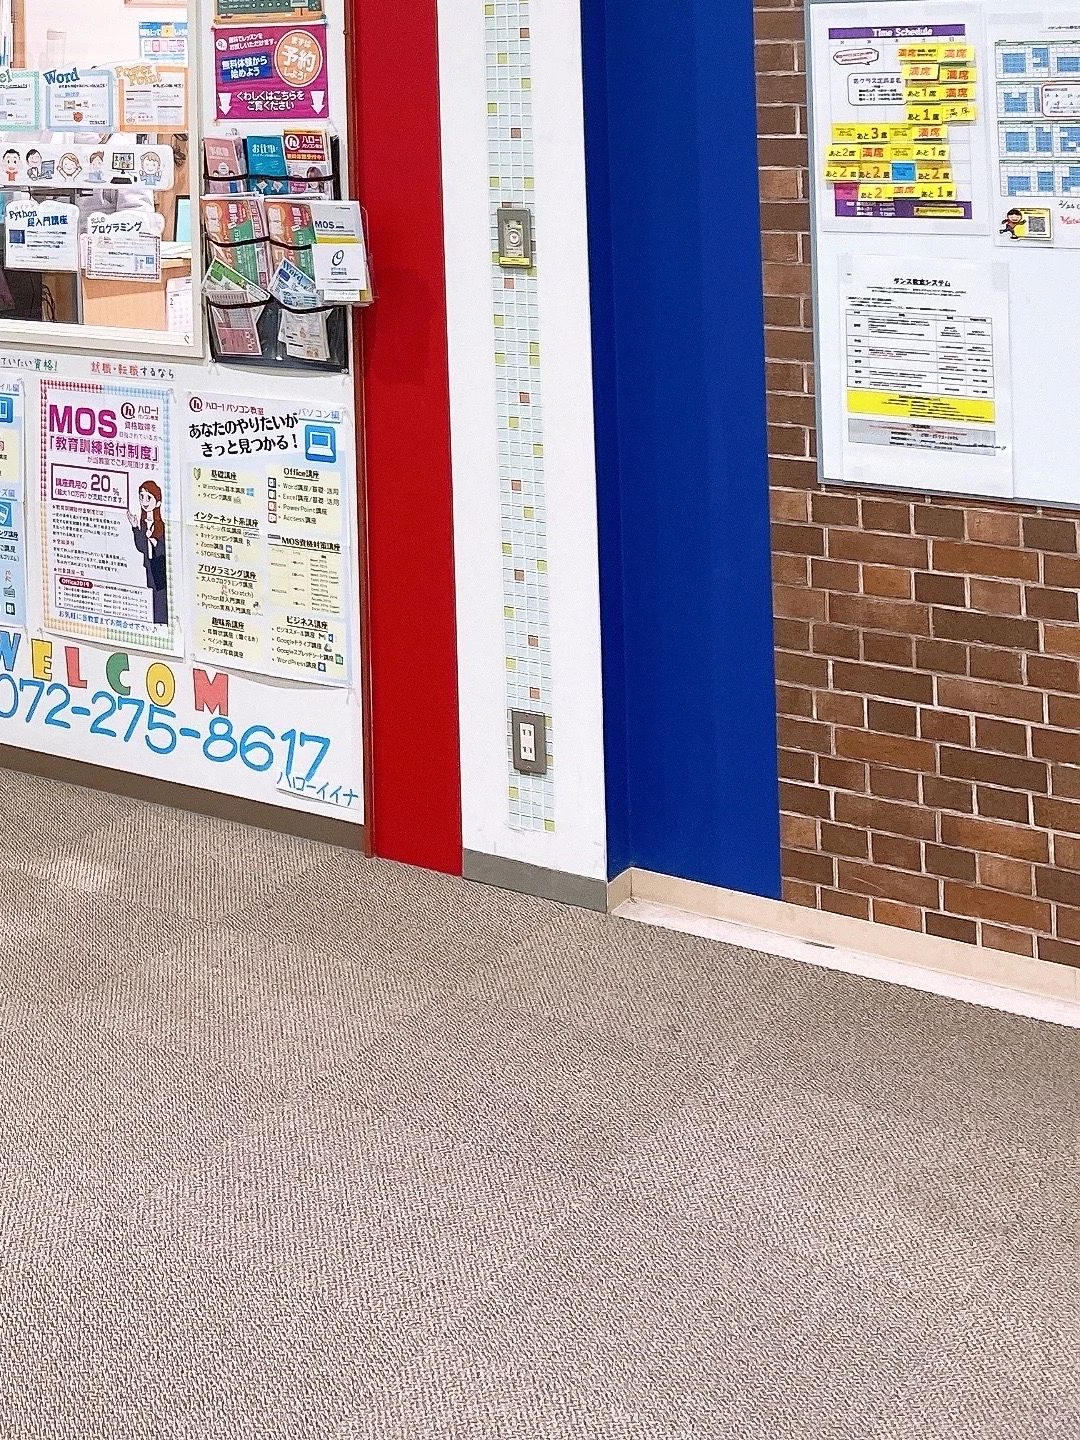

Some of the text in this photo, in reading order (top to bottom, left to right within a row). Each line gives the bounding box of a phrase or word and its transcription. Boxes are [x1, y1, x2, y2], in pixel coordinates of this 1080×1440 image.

[872, 28, 932, 37] Time Schedule
[281, 45, 316, 72] 予約
[944, 49, 967, 58] 満席
[222, 56, 267, 70] 無料体験から
[44, 67, 80, 85] Word
[231, 67, 260, 79] 始めよう
[909, 66, 931, 76] 満席
[947, 70, 969, 80] 満席
[237, 91, 304, 101] くわしくはこちらを
[946, 88, 968, 98] 満席
[247, 101, 294, 111] ご覧ください
[918, 128, 940, 138] 満席
[863, 148, 883, 157] 満席
[9, 210, 37, 221] Python
[91, 221, 143, 234] プログラミング
[315, 220, 335, 229] MOS
[894, 278, 950, 287] ダンス教室システム
[49, 404, 118, 438] MOS
[124, 421, 156, 432] 資格取得を
[189, 413, 298, 439] あなたのやりたいが
[50, 436, 158, 462] 「教育訓練給付制度」
[201, 434, 298, 457] きっと見つかる!
[211, 470, 237, 480] 基礎講座
[283, 468, 319, 479] Office講座
[194, 512, 259, 527] インターネット系講座
[282, 537, 340, 551] MOS資格対策講座
[198, 564, 256, 580] プログラミング講座
[287, 616, 328, 630] ビジネス講座
[276, 773, 359, 807] ハローイイナ
